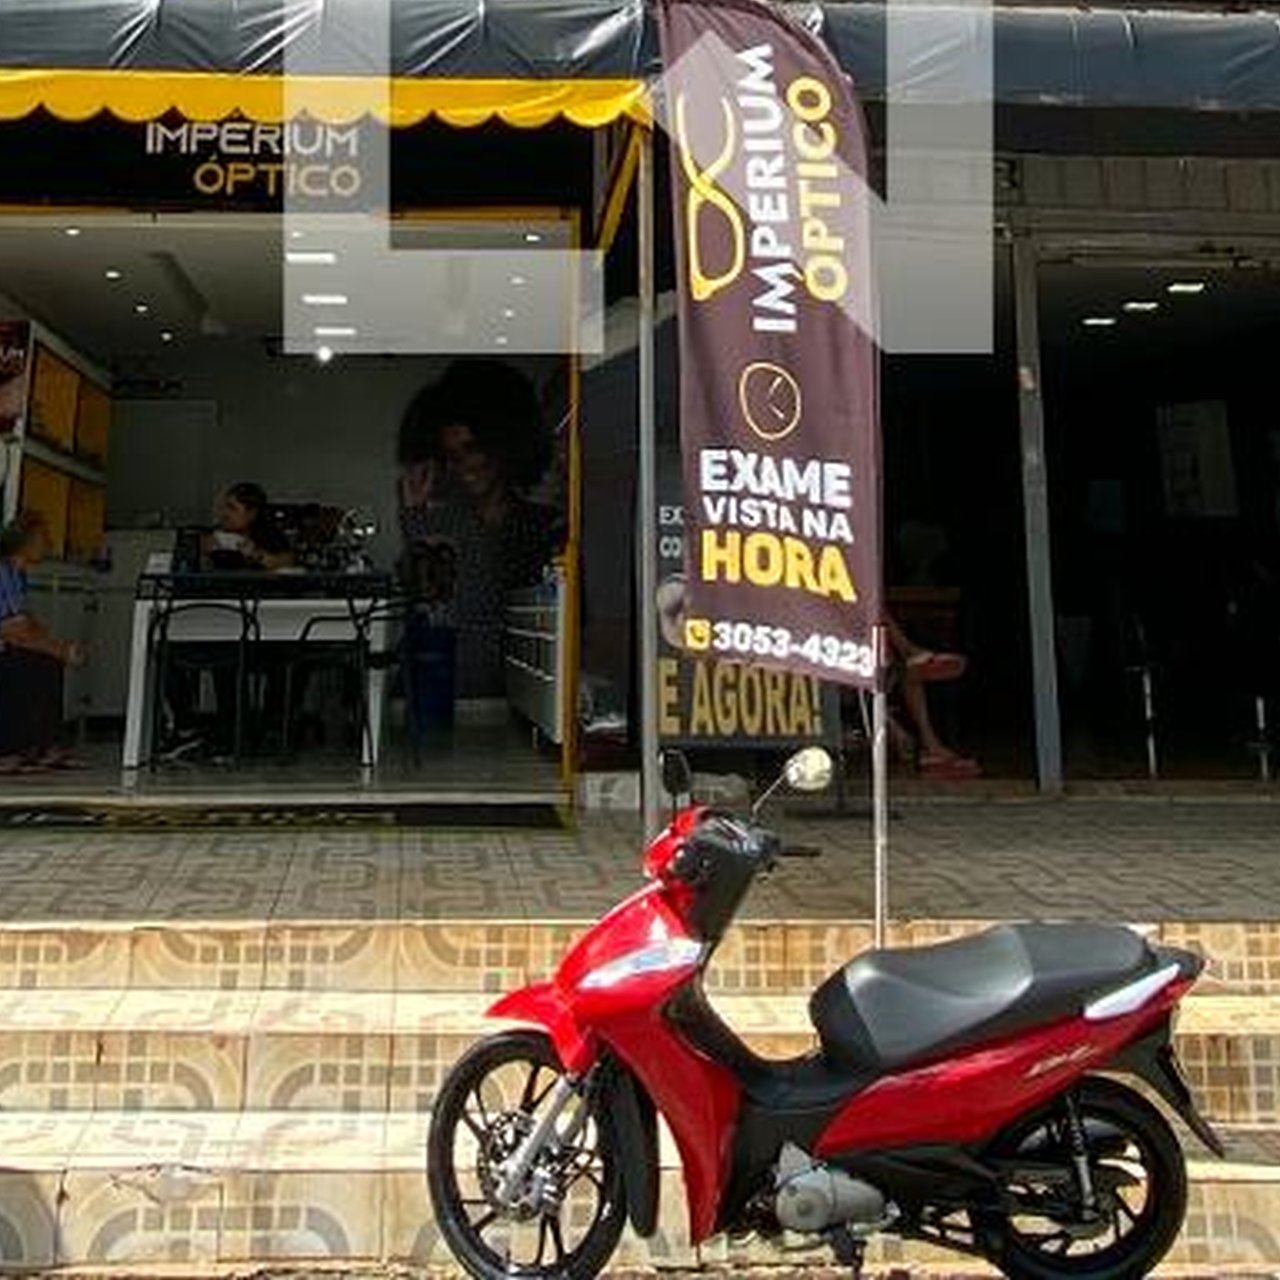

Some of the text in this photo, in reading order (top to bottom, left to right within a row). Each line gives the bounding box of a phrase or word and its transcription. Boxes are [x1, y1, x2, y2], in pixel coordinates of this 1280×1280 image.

[146, 122, 359, 157] IMPERIUM
[194, 154, 361, 197] ÓPTICO
[736, 42, 798, 333] IMPERIUM
[700, 449, 853, 508] EXAME
[703, 496, 854, 544] VISTA NA
[701, 530, 857, 603] HORA
[713, 622, 876, 678] 3053-4323
[690, 661, 821, 736] AGORA!
